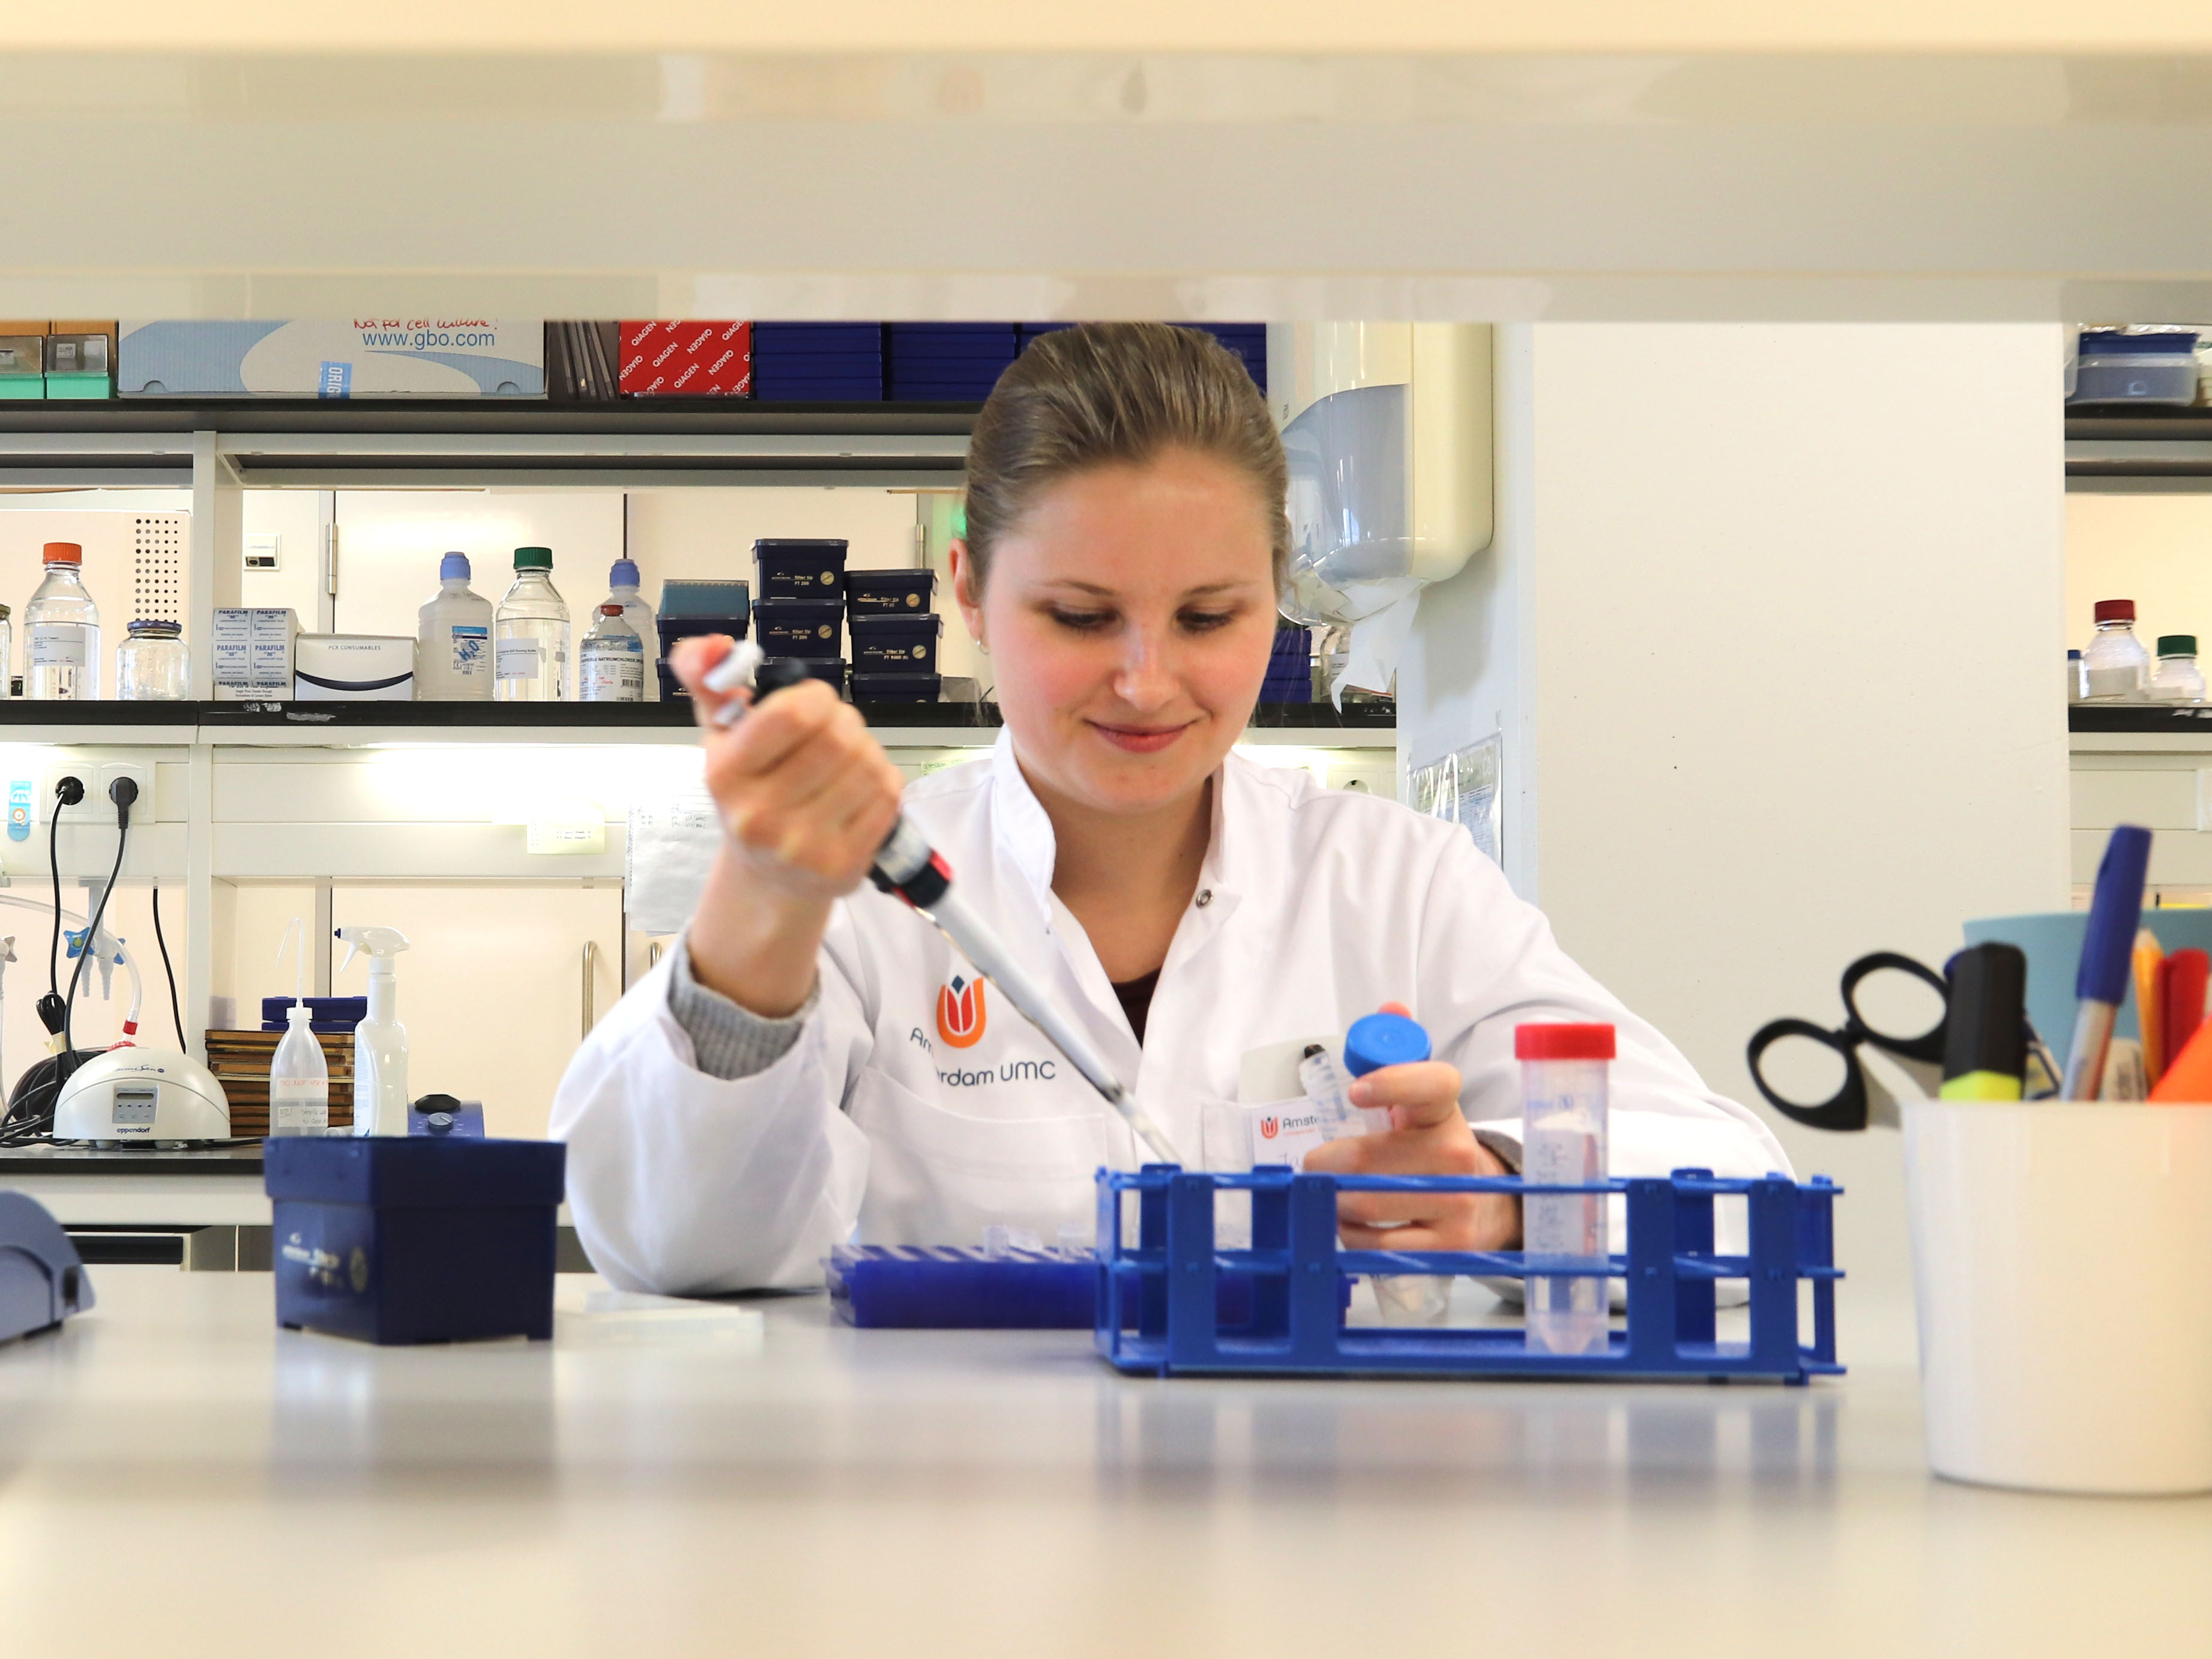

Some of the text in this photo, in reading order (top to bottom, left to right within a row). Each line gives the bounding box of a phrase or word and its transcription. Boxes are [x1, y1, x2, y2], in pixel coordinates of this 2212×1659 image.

[363, 329, 495, 350] www.gbo.com
[631, 320, 657, 346] QIAGEN
[687, 328, 713, 354] QIAGEN
[652, 341, 678, 367] QIAGEN
[708, 349, 734, 375] QIAGEN
[619, 355, 643, 381] QIAGEN
[674, 363, 699, 388] QIAGEN
[1000, 1060, 1056, 1081] UMC
